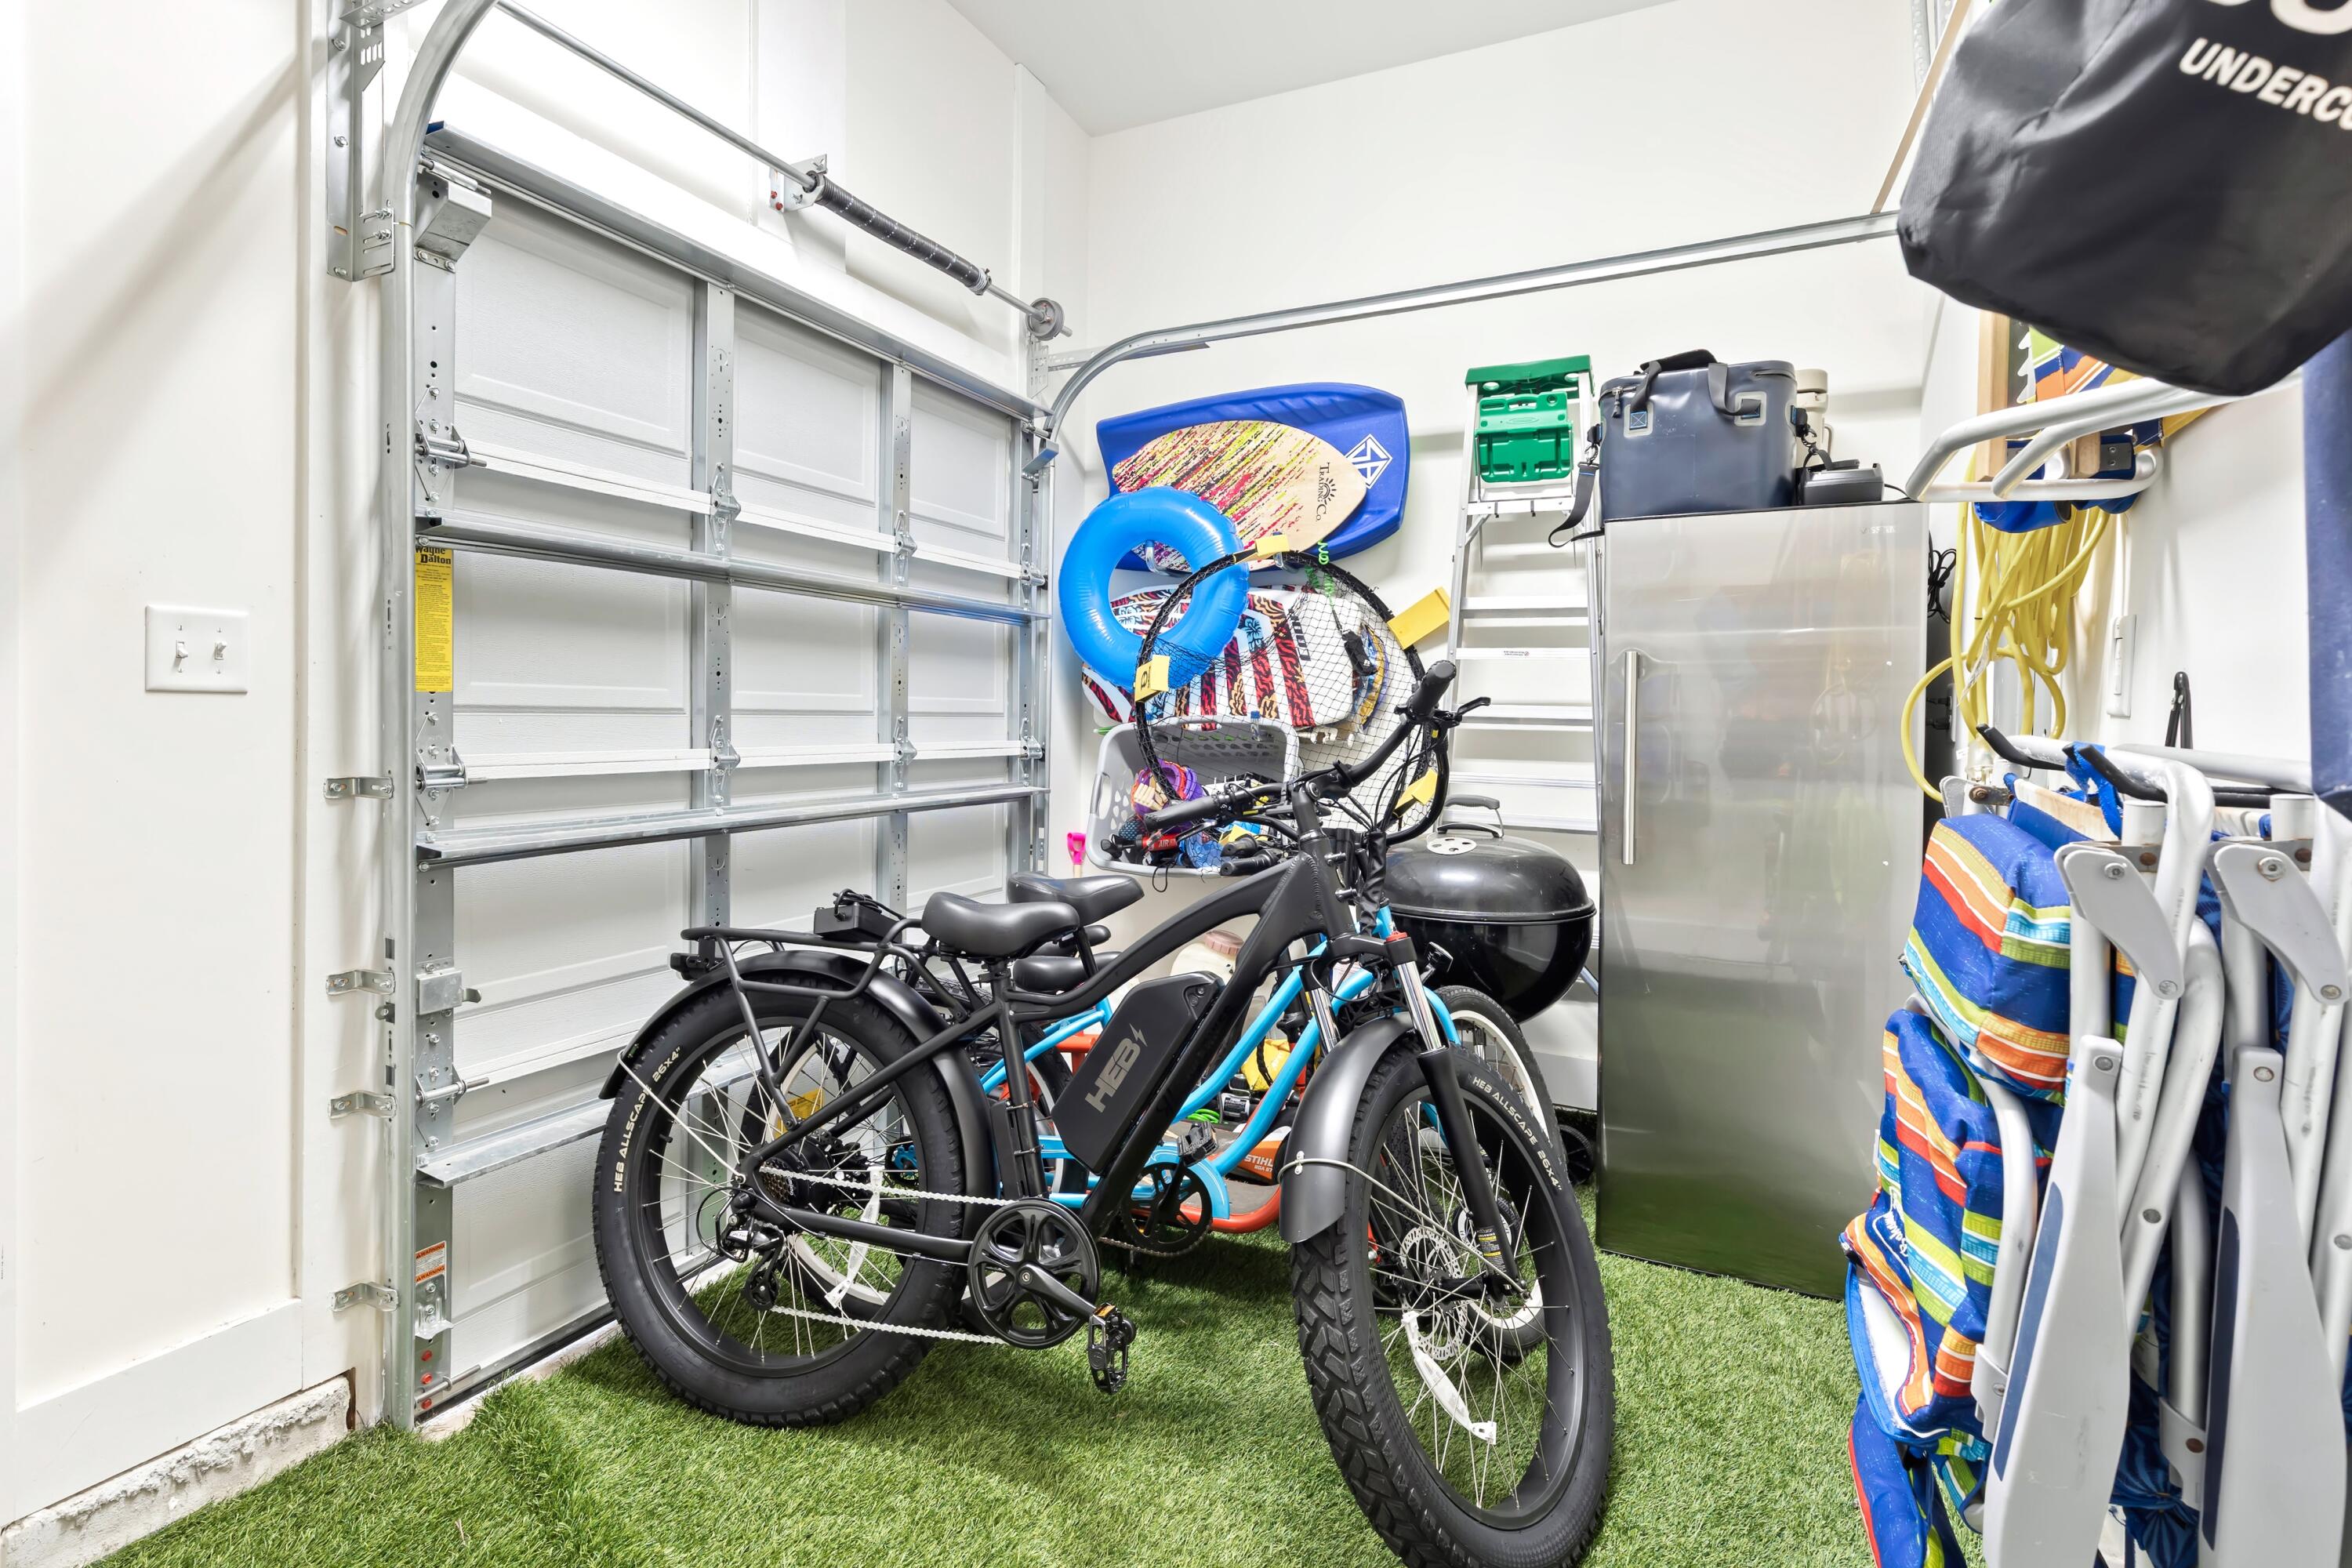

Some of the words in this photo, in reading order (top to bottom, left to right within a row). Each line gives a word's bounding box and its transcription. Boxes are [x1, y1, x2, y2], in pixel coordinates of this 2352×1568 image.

[420, 553, 452, 564] Dalton
[1085, 1037, 1142, 1113] HEB
[1472, 1076, 1493, 1094] HEB
[1491, 1091, 1538, 1145] ALLSCAPE
[1243, 1154, 1273, 1168] STIHL
[614, 1162, 625, 1192] HEB
